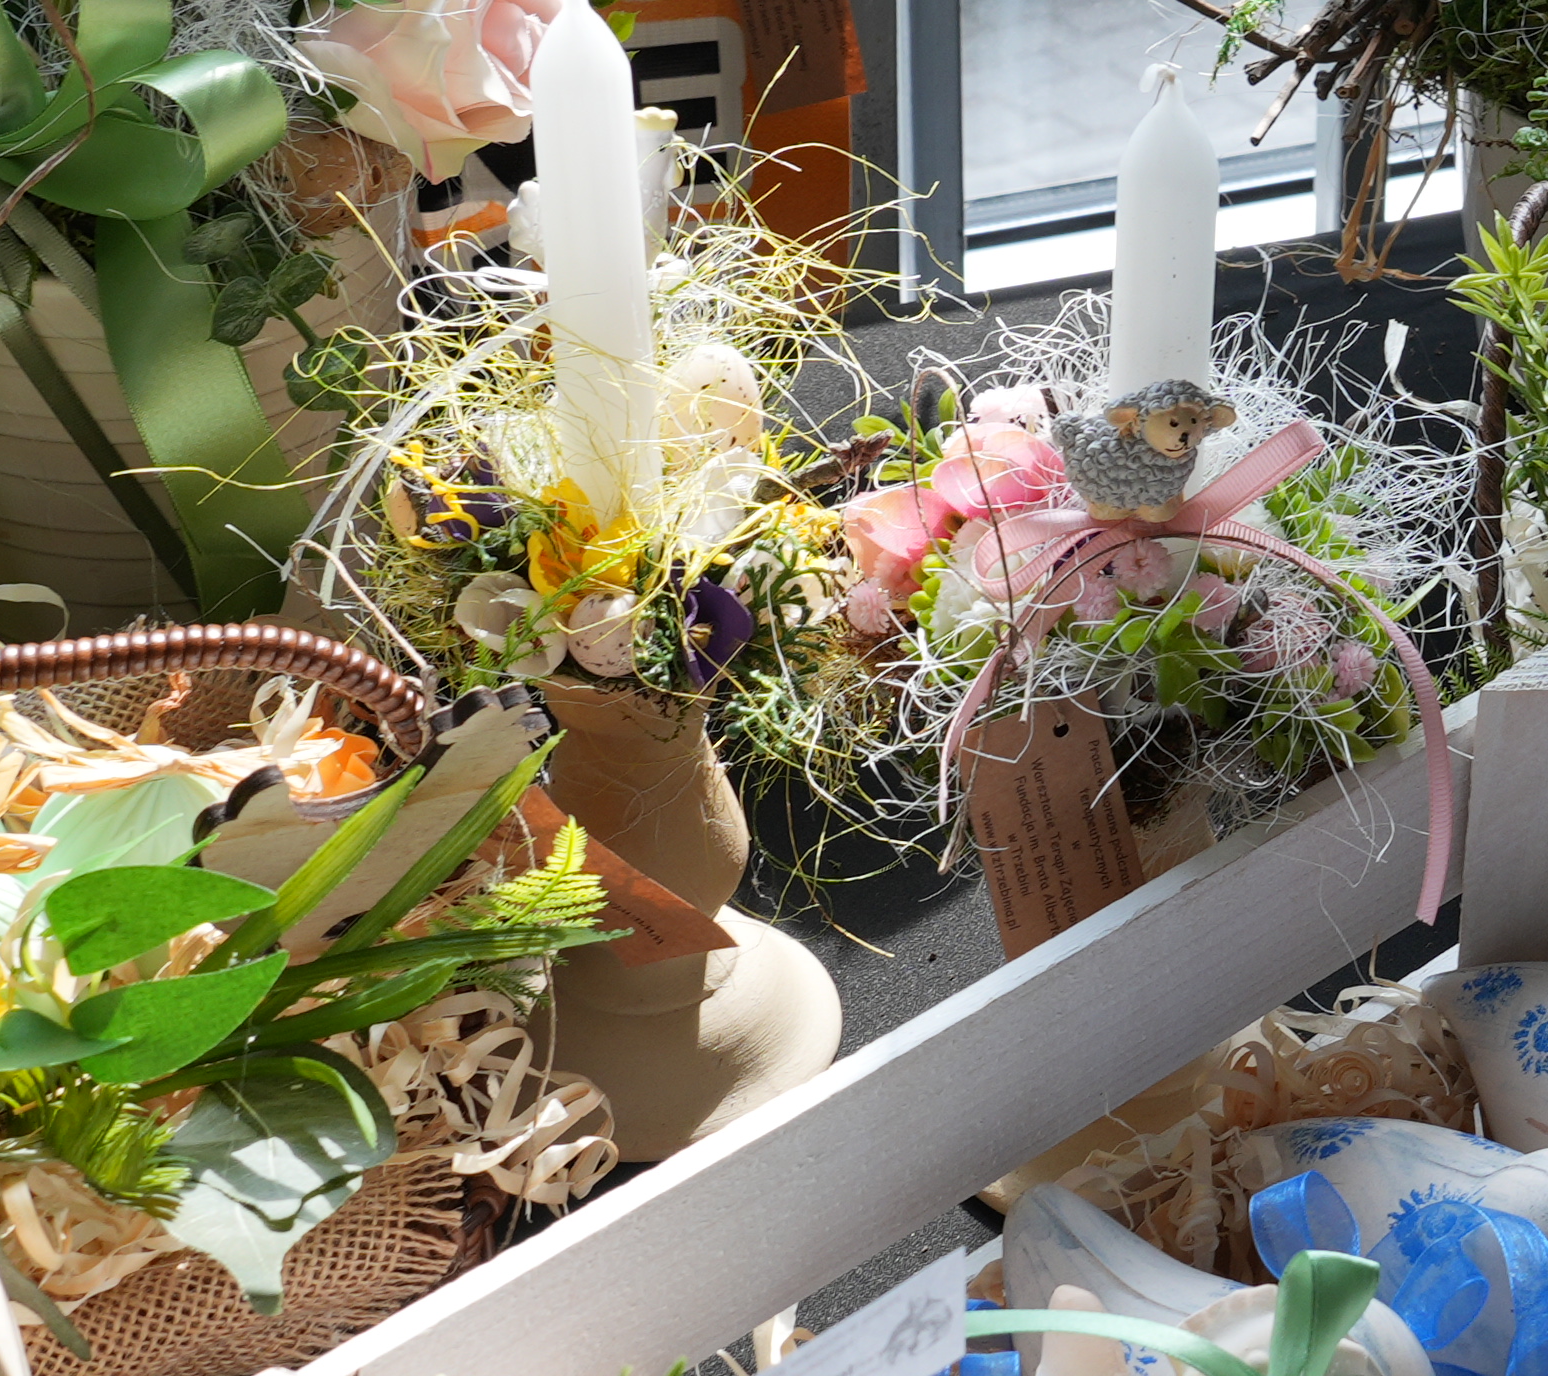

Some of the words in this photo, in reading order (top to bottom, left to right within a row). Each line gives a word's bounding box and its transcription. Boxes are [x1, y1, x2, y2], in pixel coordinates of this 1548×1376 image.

[1013, 775, 1035, 833] Fundacja
[1032, 757, 1056, 829] Warsztacie
[1049, 831, 1067, 875] Terapii
[1088, 738, 1104, 775] Praca
[1113, 837, 1131, 887] podczas
[1007, 833, 1017, 843] w
[1013, 847, 1028, 896] Trzebini
[1027, 834, 1042, 851] im.
[1071, 840, 1081, 850] w
[1079, 787, 1110, 889] terapeutycznych
[1033, 854, 1049, 890] Brata
